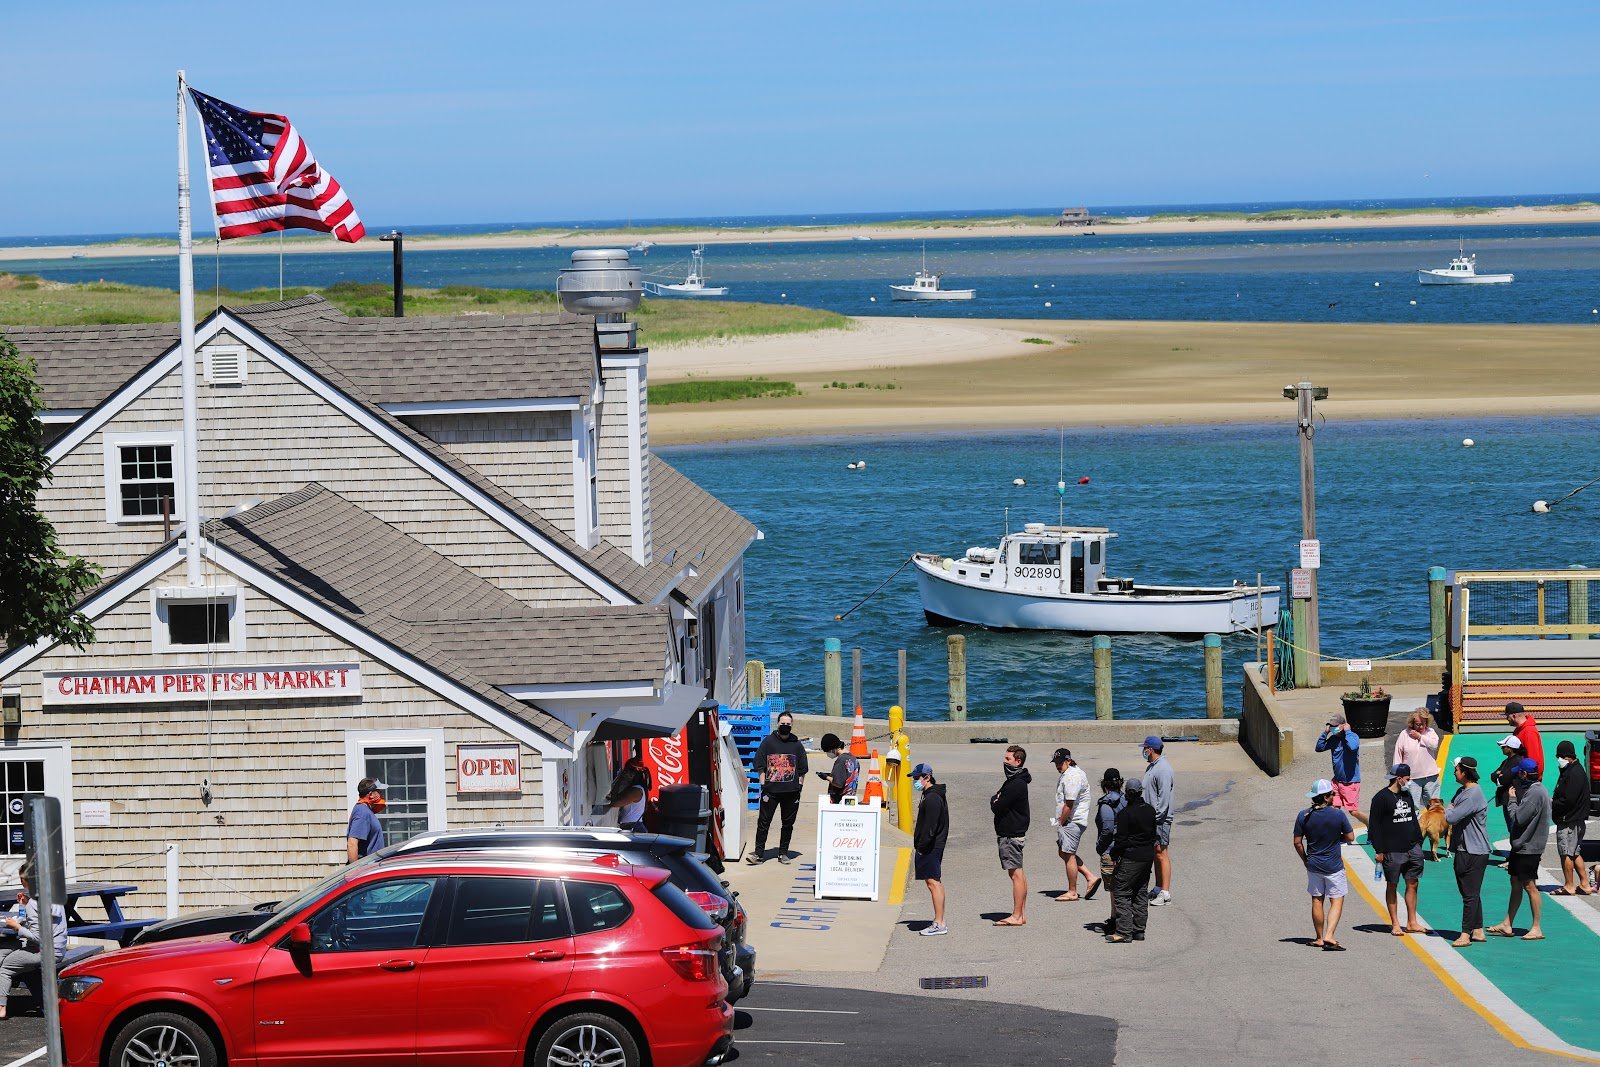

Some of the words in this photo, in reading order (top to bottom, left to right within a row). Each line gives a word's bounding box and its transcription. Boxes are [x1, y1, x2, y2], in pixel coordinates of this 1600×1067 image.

[1014, 566, 1061, 579] 902890
[58, 675, 156, 695] CHATHAM
[162, 673, 206, 694] PIER
[212, 672, 257, 692] FISH
[263, 669, 349, 689] MARKET
[461, 758, 517, 776] OPEN
[832, 837, 867, 849] OPEN!
